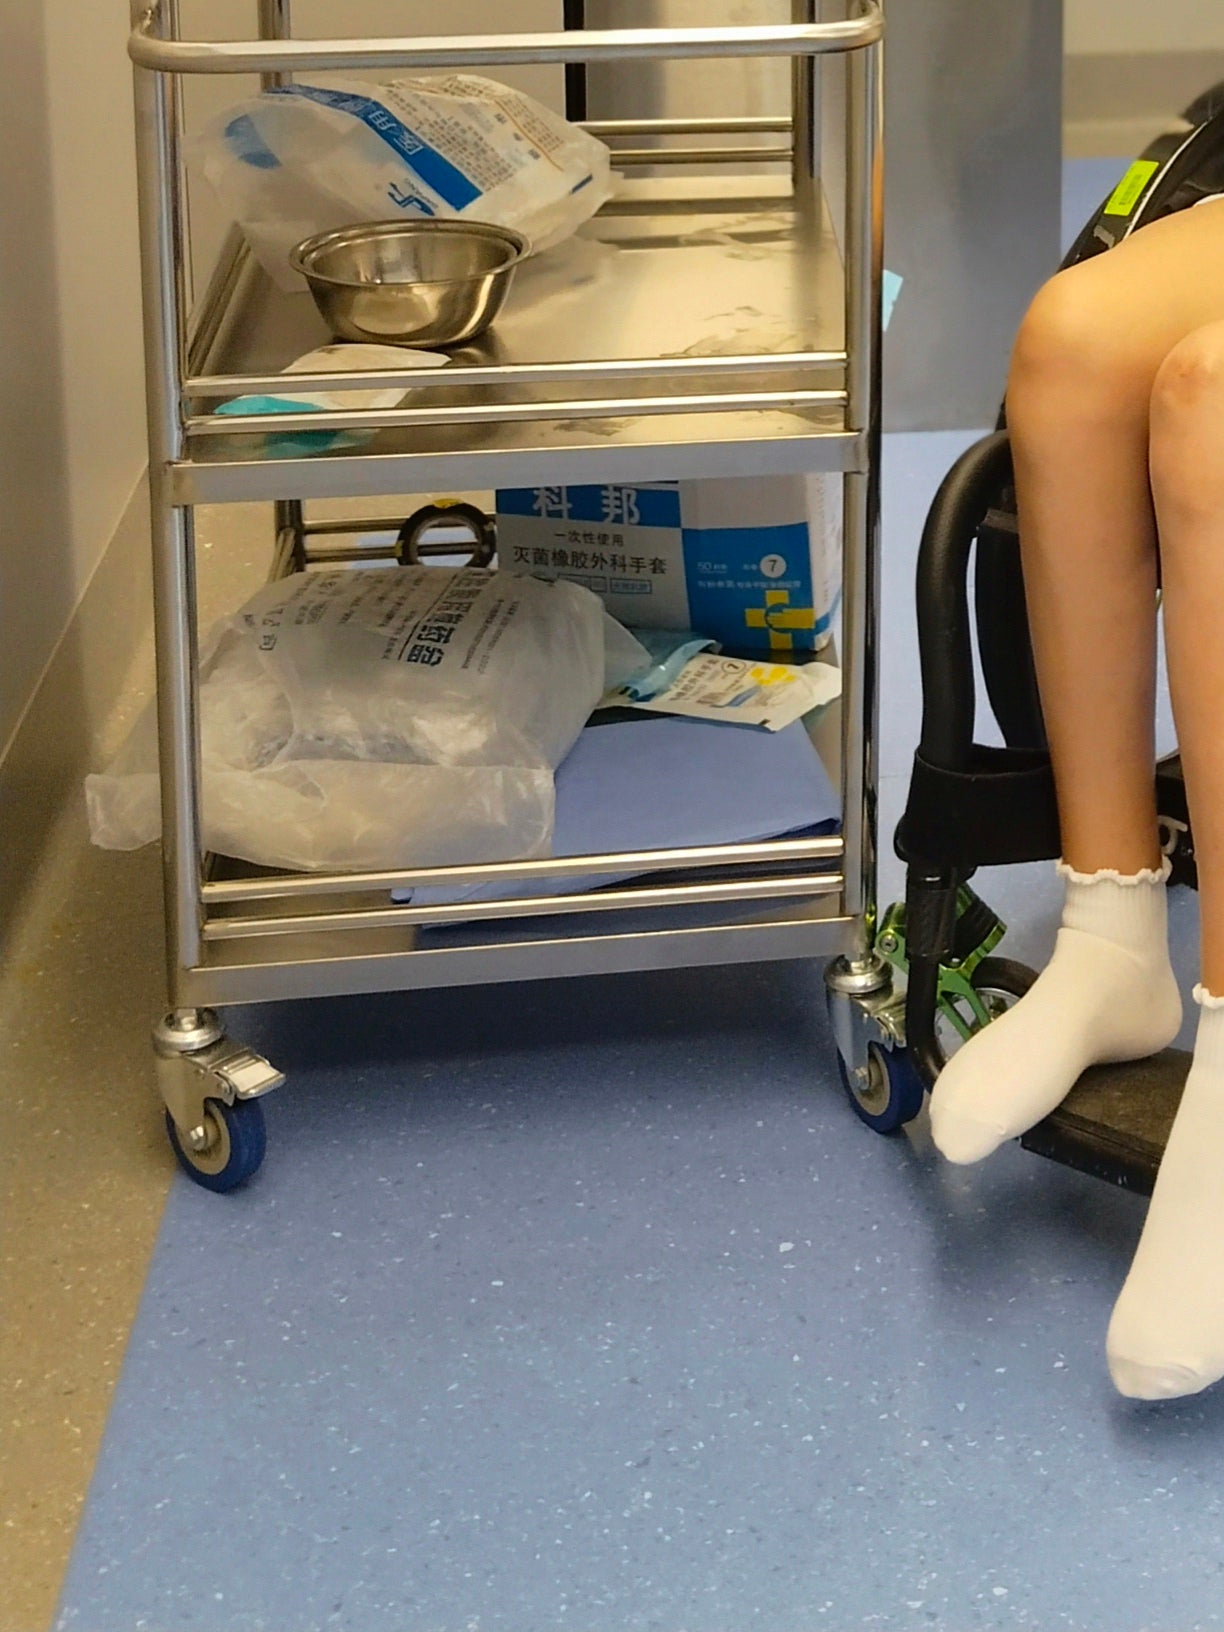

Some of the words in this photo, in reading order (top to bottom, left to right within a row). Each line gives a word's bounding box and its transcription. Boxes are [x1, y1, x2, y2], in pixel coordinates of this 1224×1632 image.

[532, 485, 640, 525] 科邦
[553, 529, 625, 547] 一次性使用
[513, 545, 668, 575] 灭菌橡胶外科手套
[768, 559, 778, 573] 7
